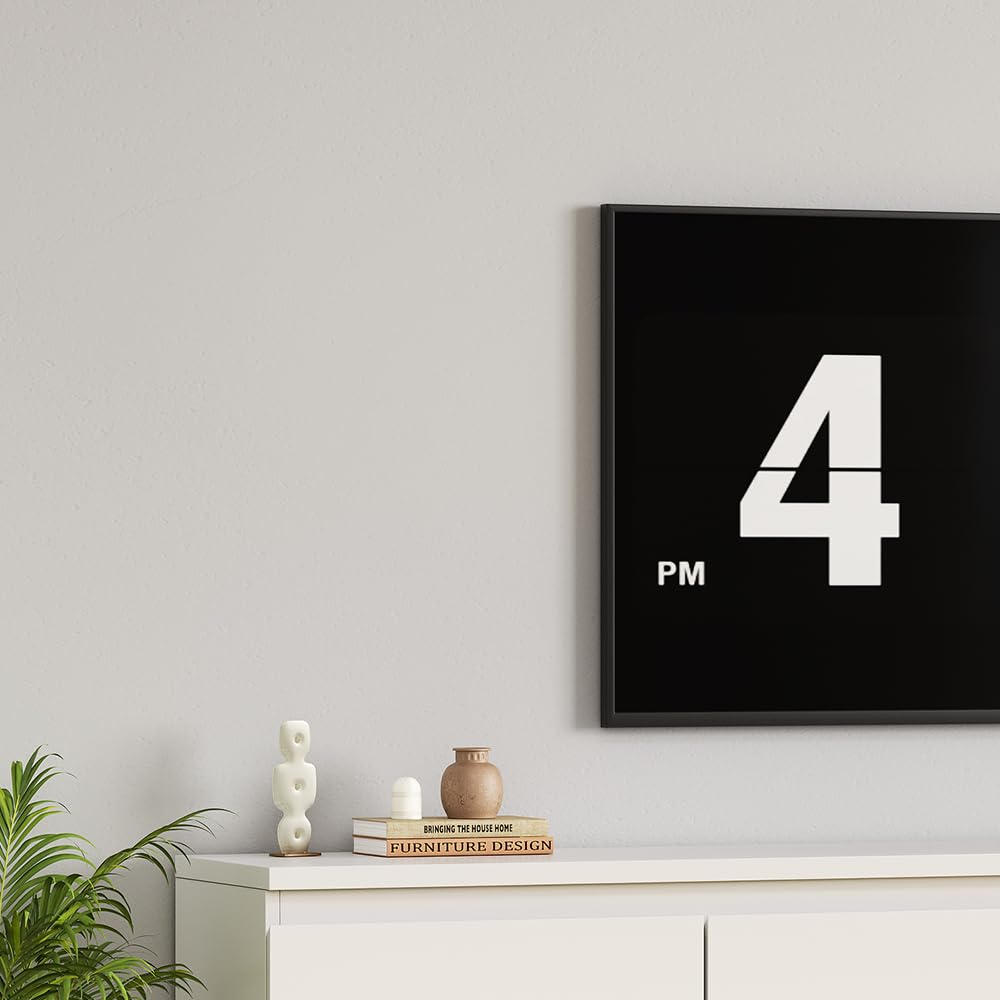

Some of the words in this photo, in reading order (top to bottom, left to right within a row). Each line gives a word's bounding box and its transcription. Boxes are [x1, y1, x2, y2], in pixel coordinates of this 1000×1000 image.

[739, 354, 900, 586] 4
[657, 561, 705, 586] PM
[423, 824, 456, 834] BRINGING
[457, 824, 470, 833] THE
[471, 824, 493, 833] HOUSE
[494, 823, 513, 833] HOME
[390, 841, 487, 853] FURNITURE
[492, 840, 552, 852] DESIGN
